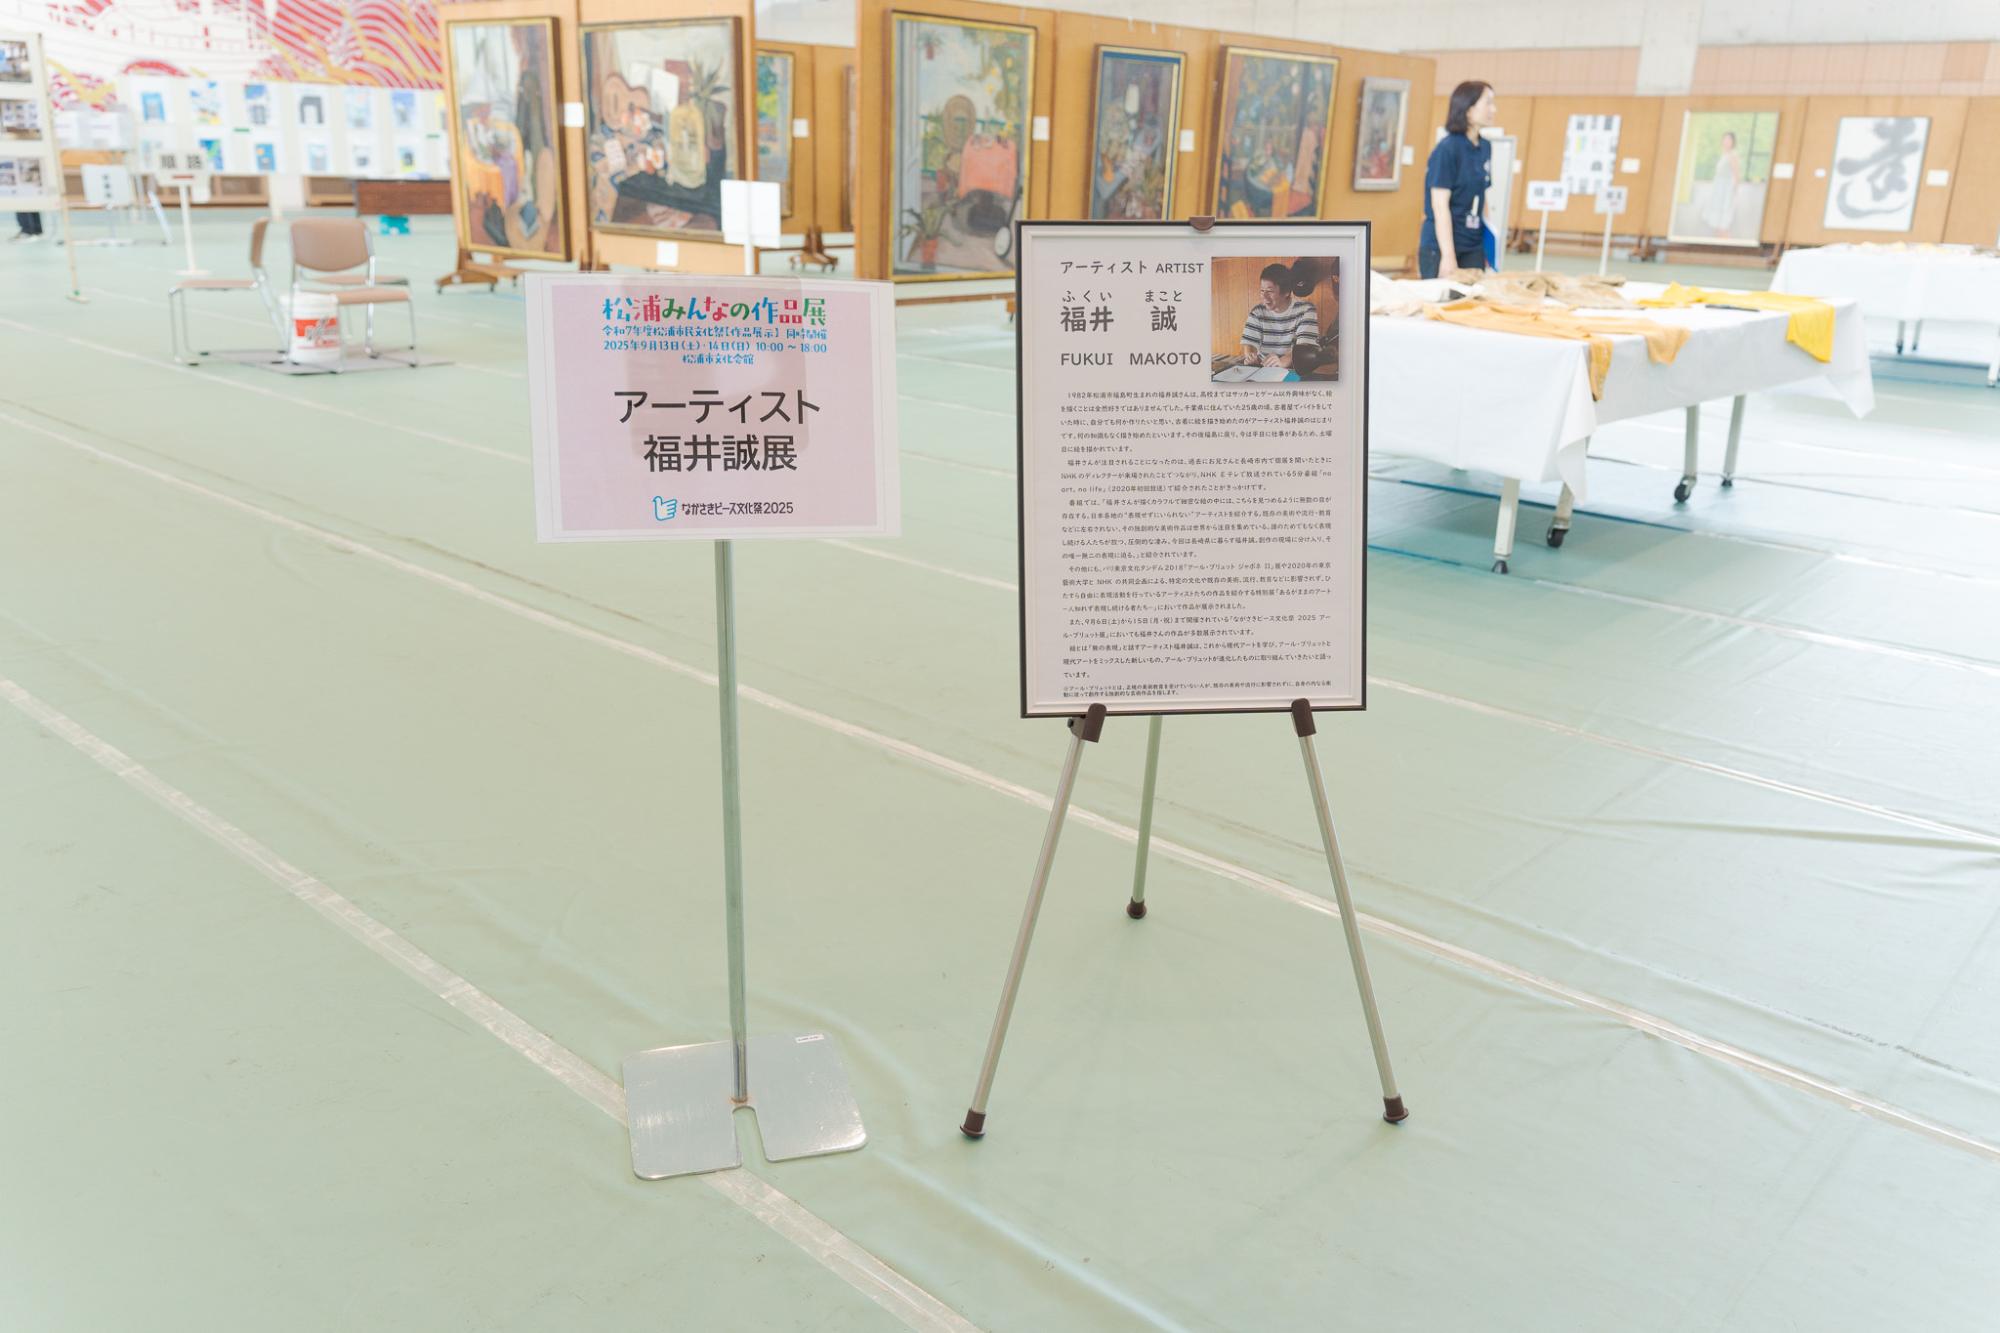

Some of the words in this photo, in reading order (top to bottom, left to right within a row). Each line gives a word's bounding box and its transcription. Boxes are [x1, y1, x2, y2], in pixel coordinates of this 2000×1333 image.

[1060, 260, 1148, 275] アーティスト
[1155, 262, 1205, 274] ARTIST
[1061, 289, 1113, 303] ふくい
[1144, 289, 1183, 303] まこと
[602, 294, 826, 327] 松浦みんなの作品展
[1060, 305, 1115, 332] 福井
[1149, 305, 1178, 332] 誠
[756, 342, 784, 352] 10:00
[800, 343, 827, 352] 18:00
[682, 353, 754, 365] 松浦市文化会館
[1060, 352, 1113, 366] FUKUI
[1129, 352, 1202, 366] MAKOTO
[613, 388, 820, 425] アーティスト
[643, 433, 798, 473] 福井誠展
[681, 501, 794, 516] ながさきピース文化祭2025
[1064, 671, 1090, 679] ています。
